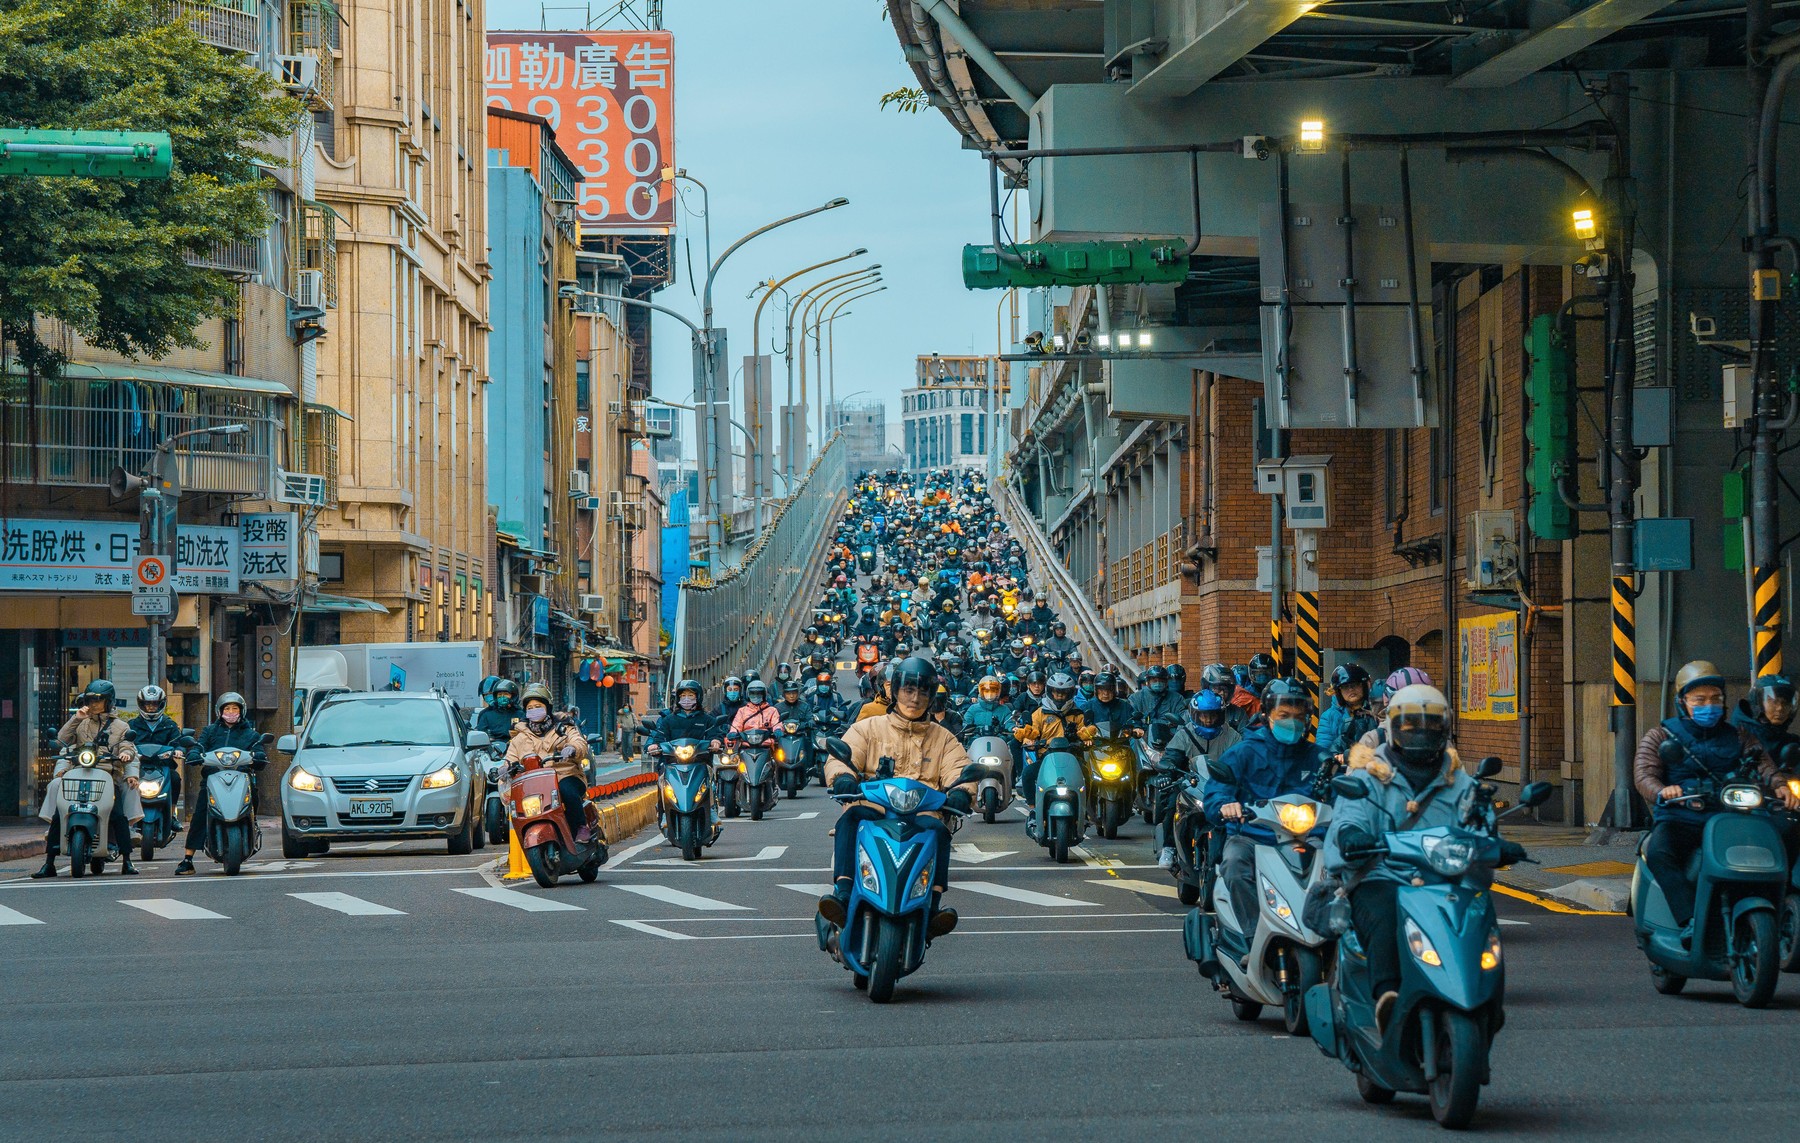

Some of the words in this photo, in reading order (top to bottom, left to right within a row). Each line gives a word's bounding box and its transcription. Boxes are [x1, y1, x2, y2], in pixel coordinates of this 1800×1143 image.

[242, 518, 287, 543] 投幣
[145, 565, 159, 579] 停
[242, 551, 287, 575] 洗衣
